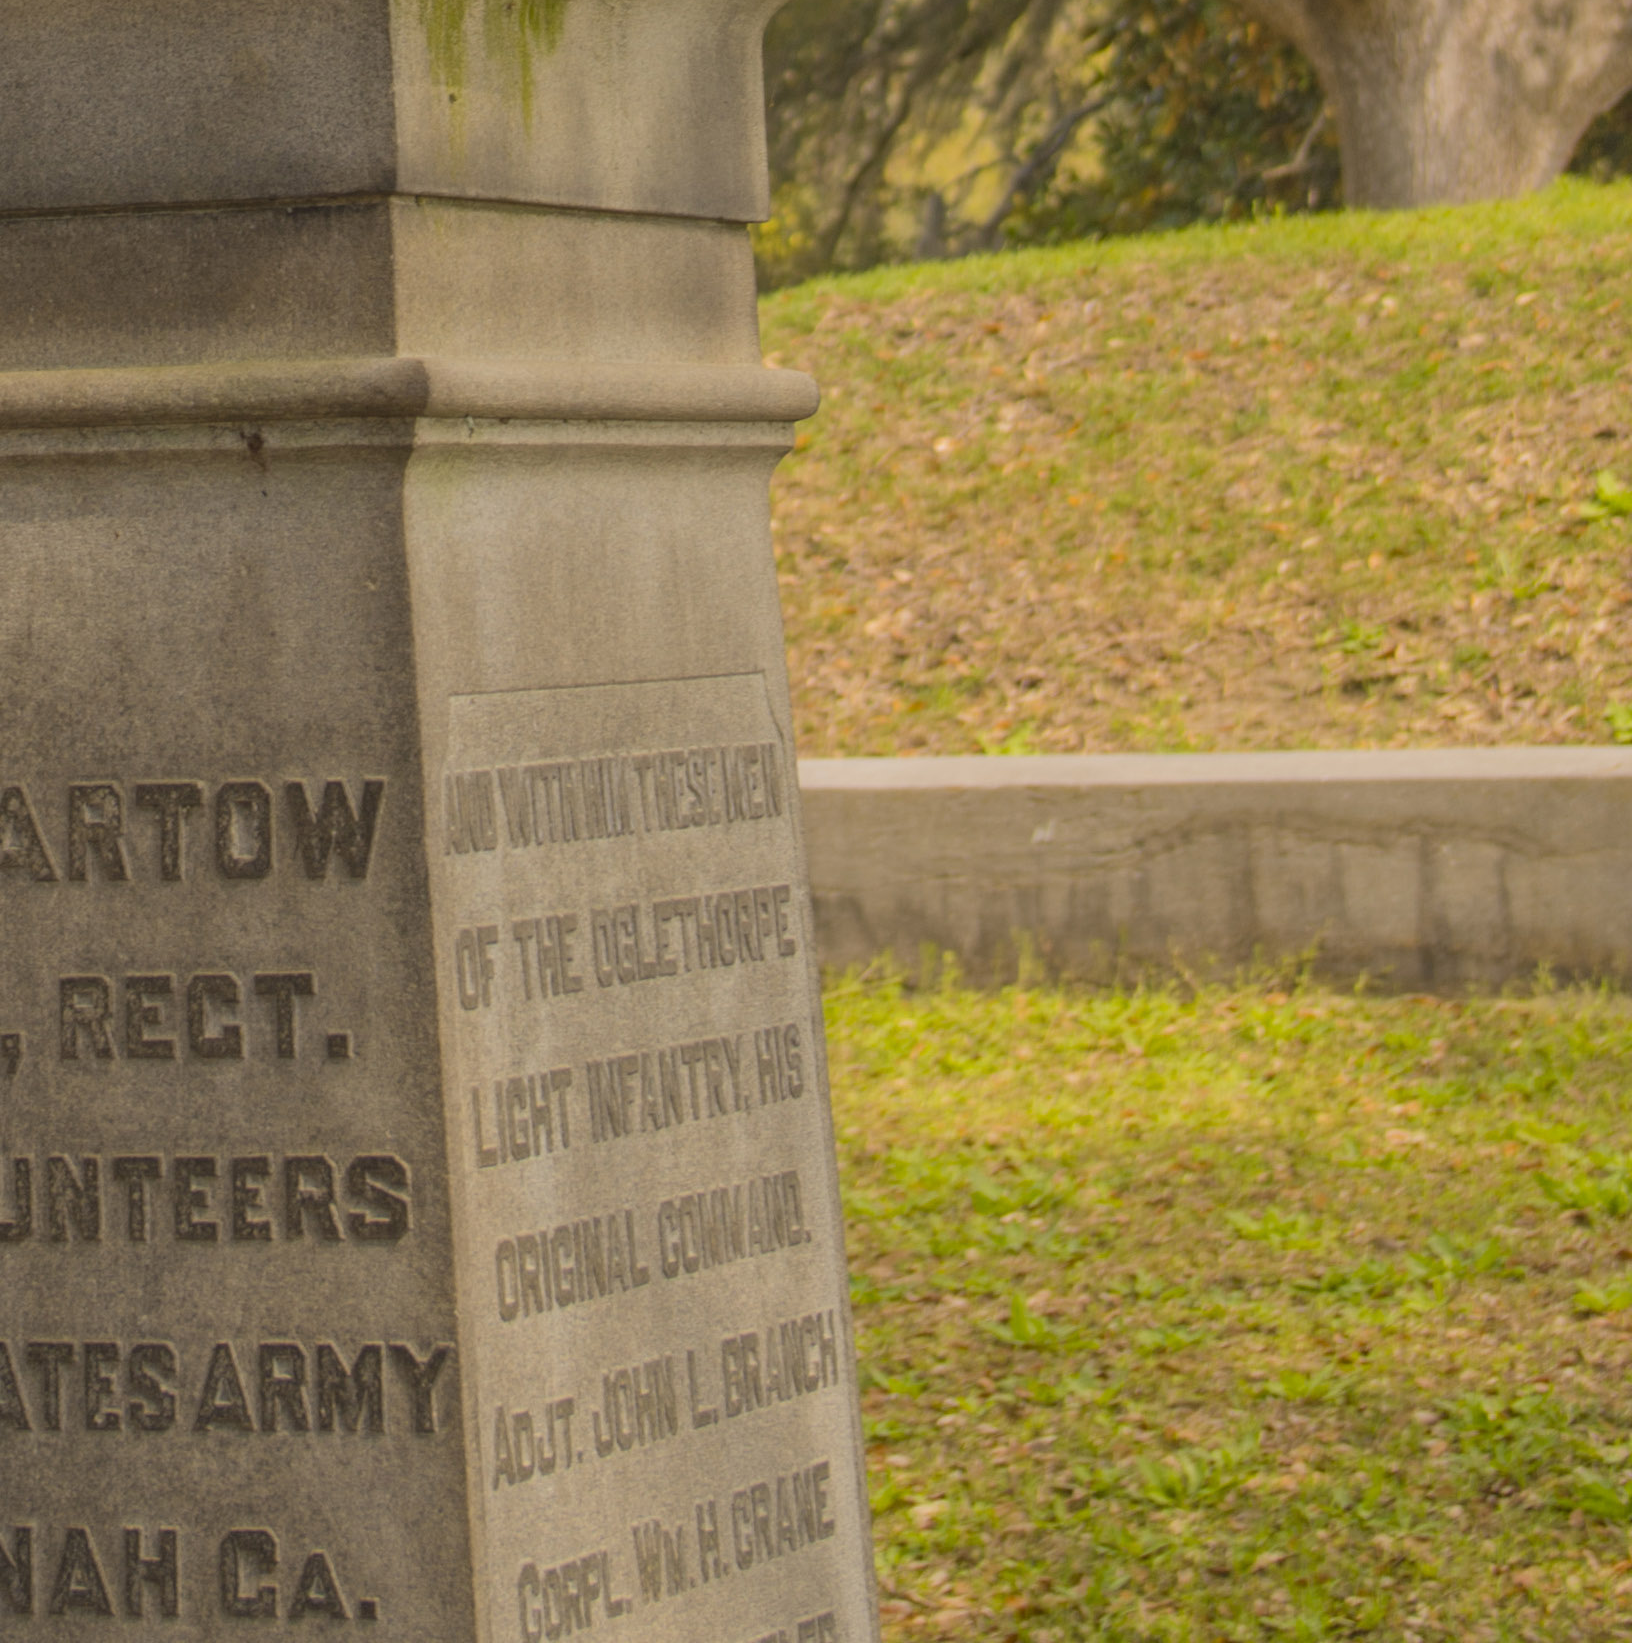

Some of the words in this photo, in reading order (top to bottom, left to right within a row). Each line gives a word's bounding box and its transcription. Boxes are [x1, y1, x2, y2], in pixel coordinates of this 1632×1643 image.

[444, 767, 499, 856] AND
[497, 759, 579, 849] WITH
[631, 747, 721, 833] THESE
[720, 741, 783, 824] MEN
[455, 923, 499, 1011] OF
[511, 913, 584, 1001] THE
[589, 884, 796, 989] OGLETHORPE
[58, 971, 355, 1061] REGT.
[471, 1067, 572, 1169] LIGHT
[753, 1022, 805, 1106] HIS
[495, 1209, 651, 1323] ORIGINAL
[192, 1339, 456, 1436] ARMY
[492, 1396, 584, 1492] ADJT.
[592, 1353, 679, 1460] JOHN
[686, 1348, 720, 1430] L.
[720, 1308, 839, 1419] BRANCH
[219, 1526, 380, 1620] GA.
[517, 1548, 633, 1643] CORPL.
[695, 1499, 730, 1584] H.
[731, 1460, 836, 1571] CRANE
